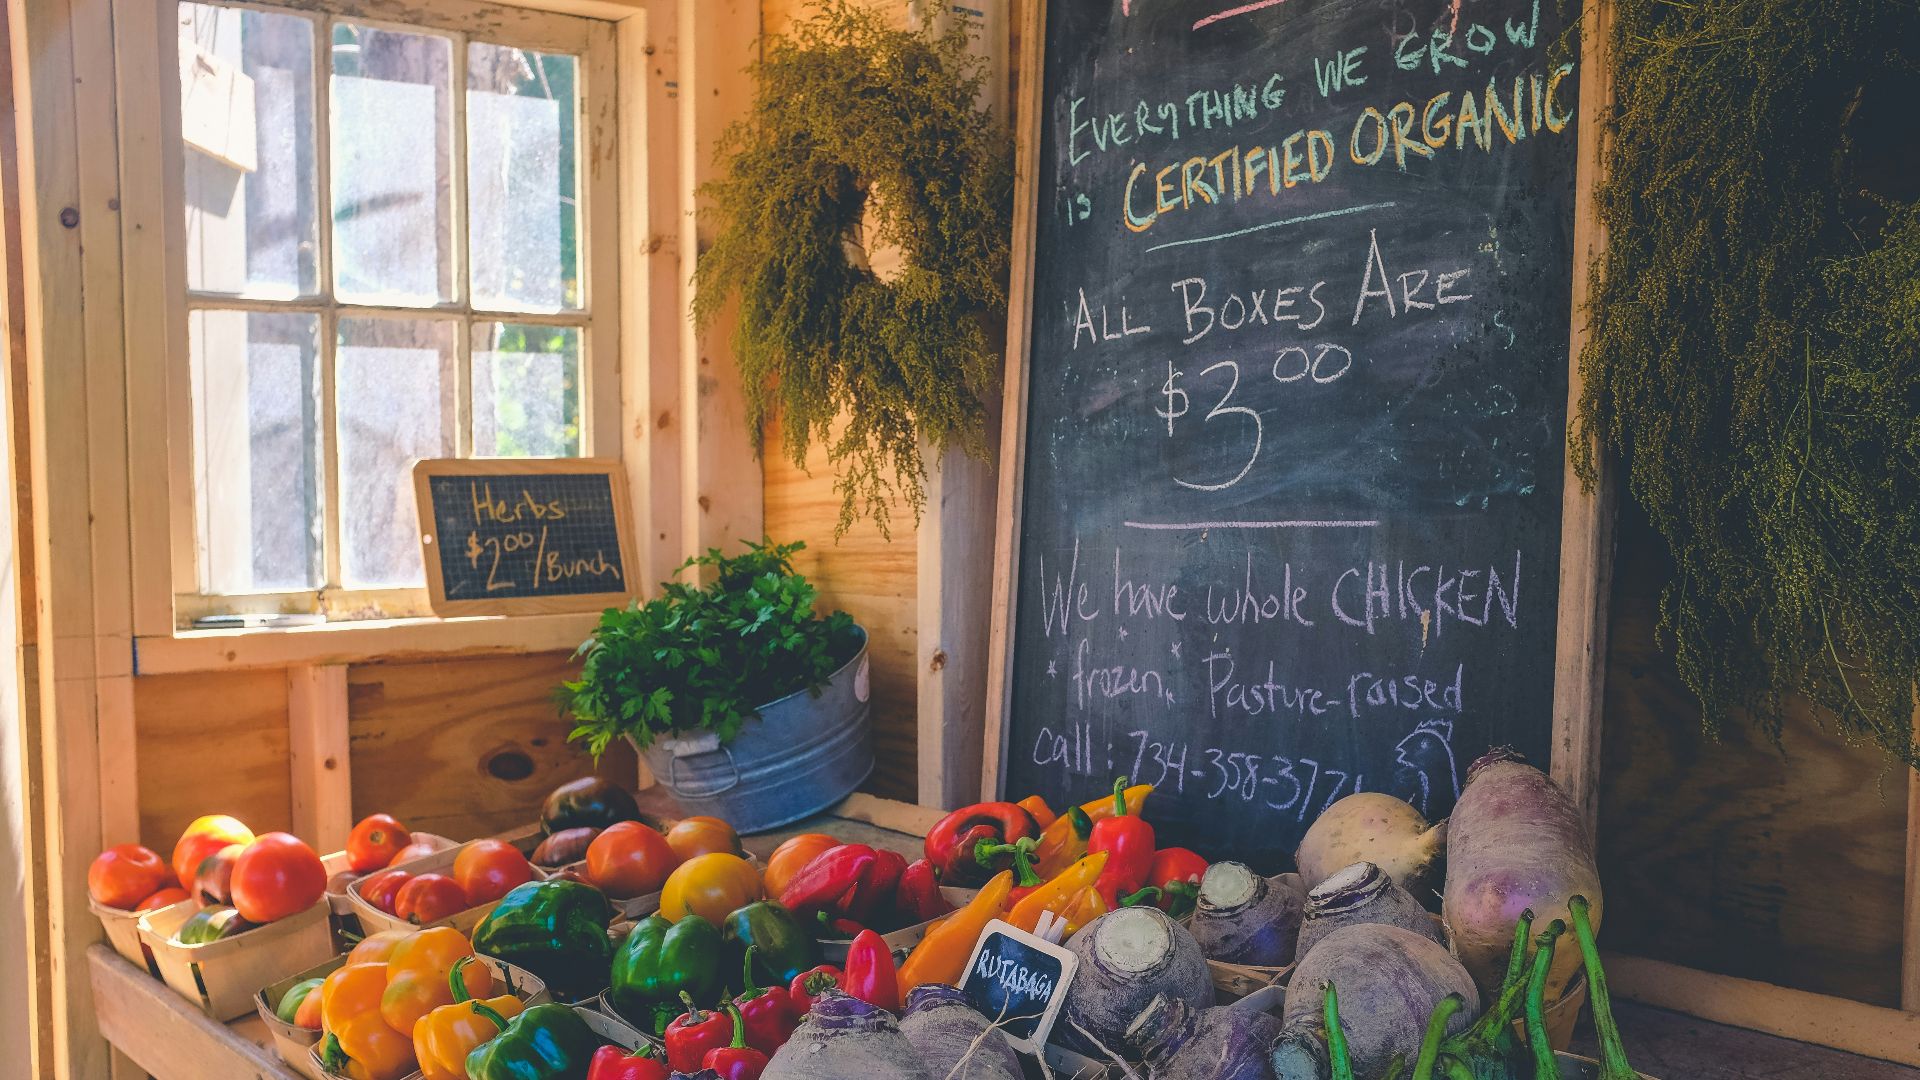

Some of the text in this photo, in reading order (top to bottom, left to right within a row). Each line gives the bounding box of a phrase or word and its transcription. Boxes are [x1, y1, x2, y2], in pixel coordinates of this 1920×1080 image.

[1068, 74, 1286, 166] EVERYTHING
[1314, 45, 1369, 98] WE
[1394, 0, 1540, 74] GROW
[1123, 129, 1334, 233] CERTIFIED
[1350, 62, 1575, 174] ORGANIC
[1072, 227, 1474, 350] ALL BOXES ARE
[472, 480, 566, 525] Herbs
[1040, 537, 1521, 638] We have whole CHICKEN
[1202, 650, 1464, 719] Pasture-raised
[976, 948, 1052, 1004] RUTABAGA
